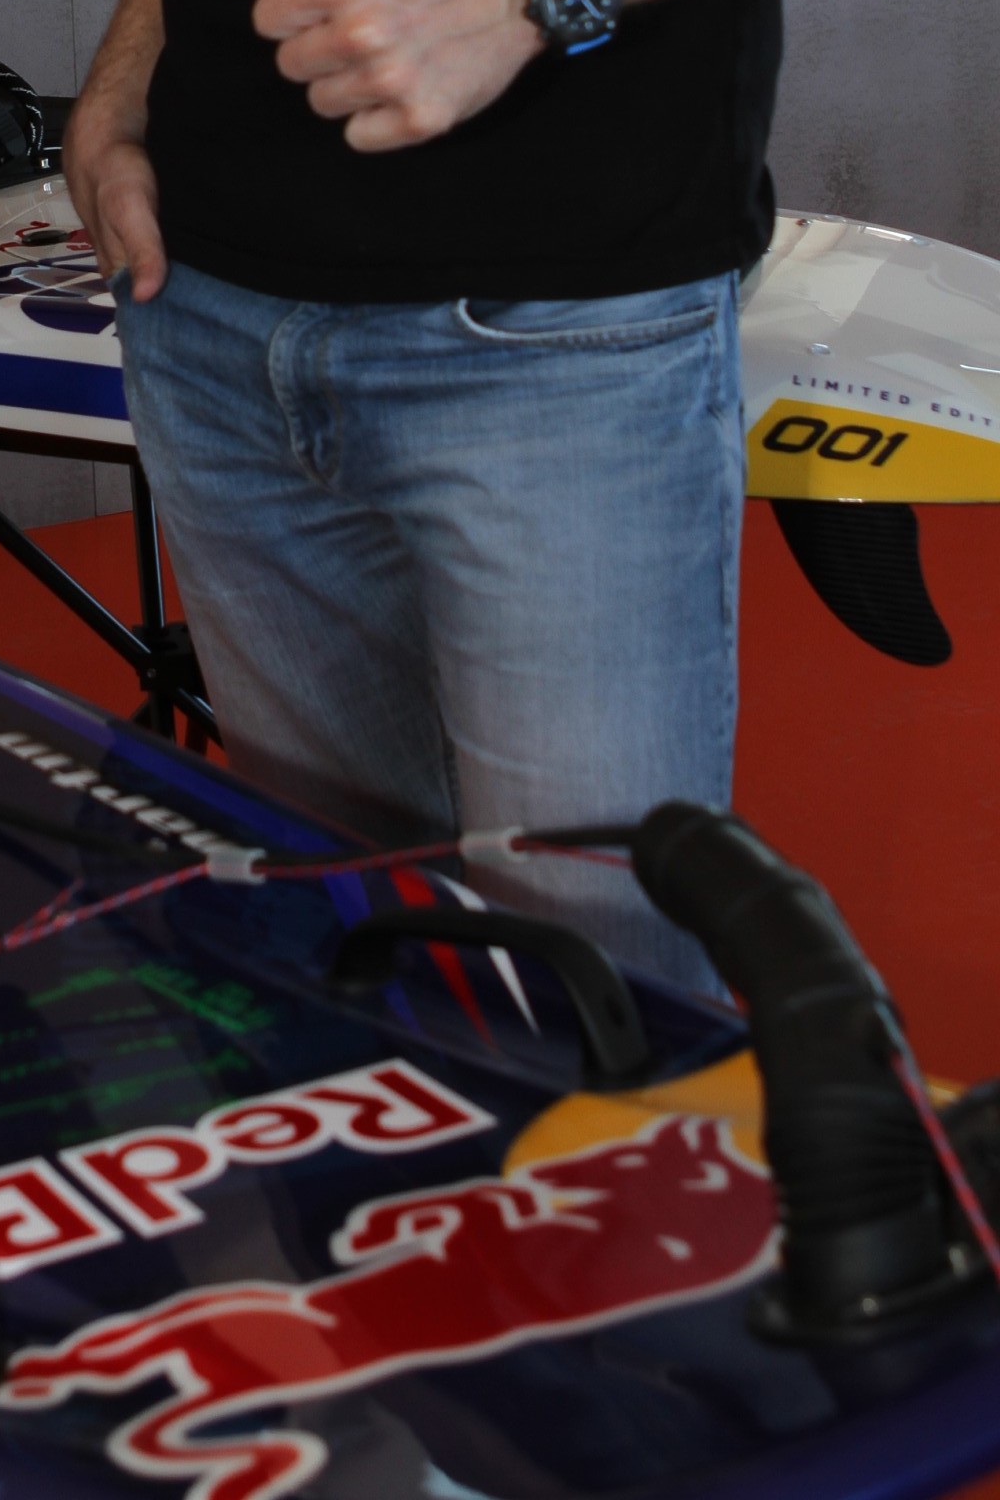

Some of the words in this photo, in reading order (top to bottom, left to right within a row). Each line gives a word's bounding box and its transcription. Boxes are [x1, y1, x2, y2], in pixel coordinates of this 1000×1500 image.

[792, 374, 911, 405] LIMITED
[762, 415, 909, 467] 001
[61, 1059, 497, 1238] Red
